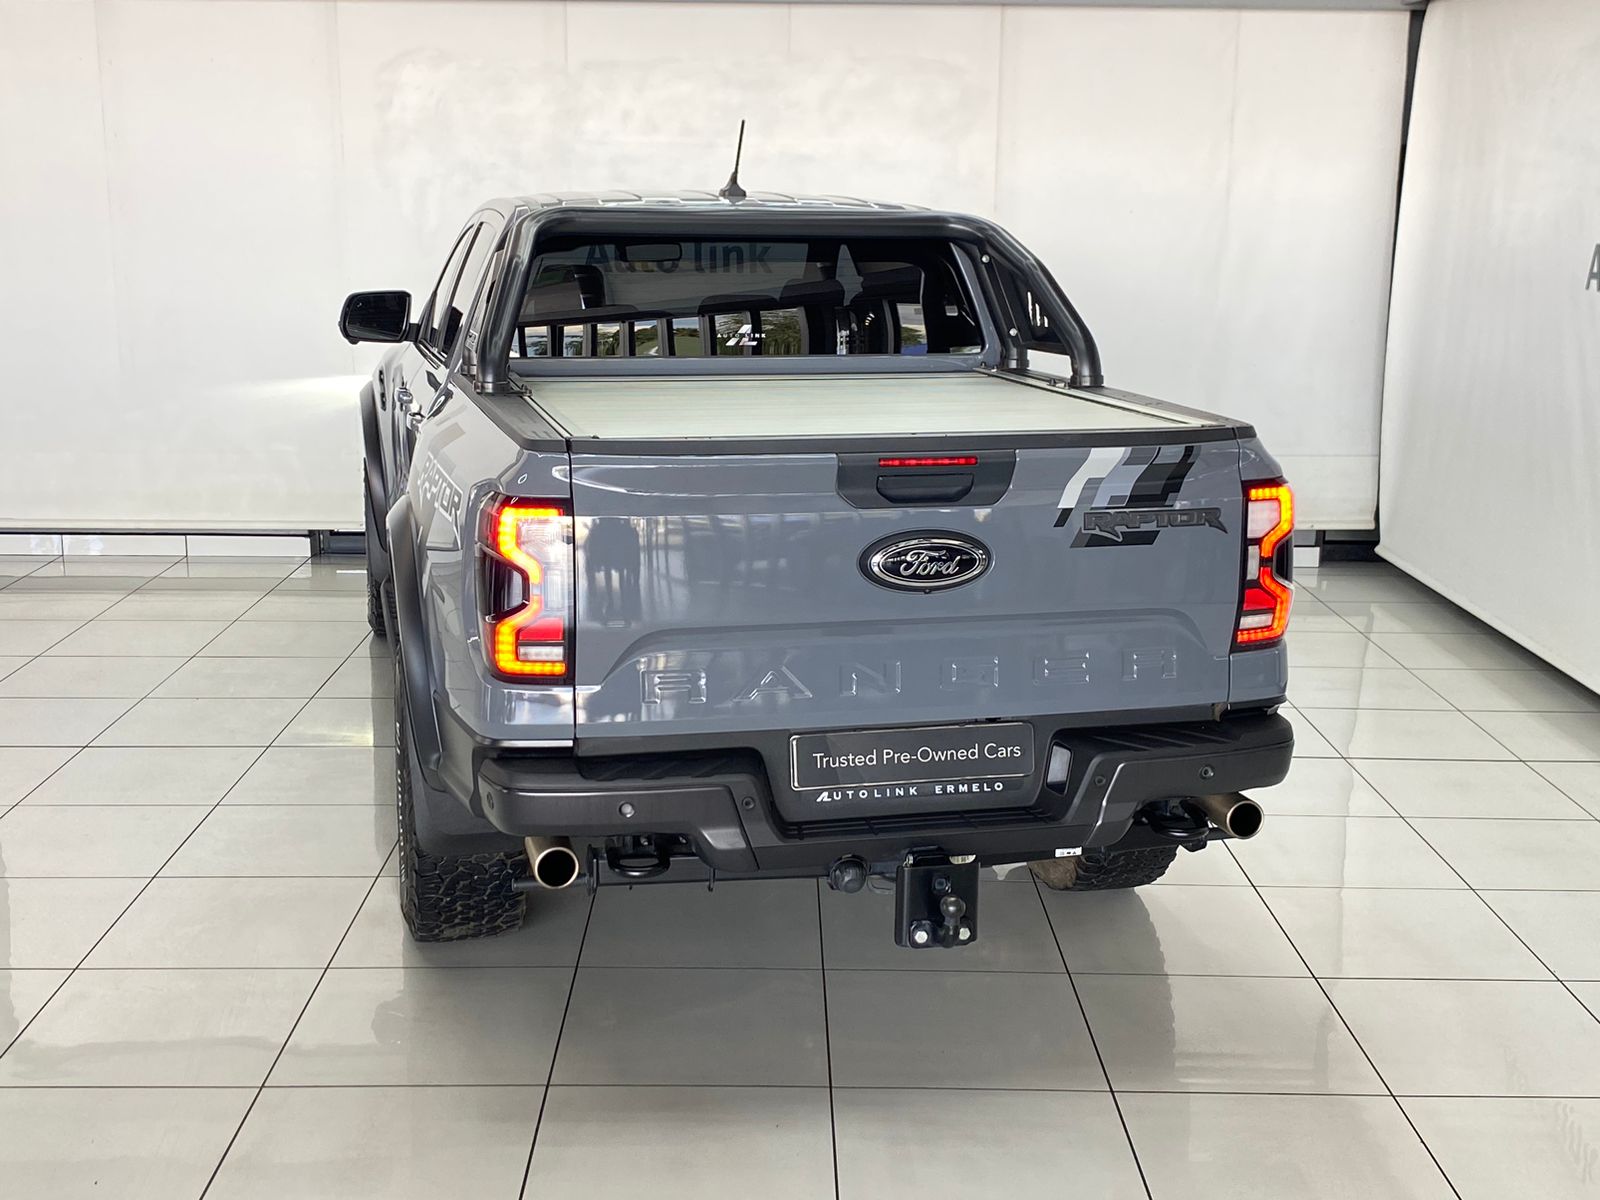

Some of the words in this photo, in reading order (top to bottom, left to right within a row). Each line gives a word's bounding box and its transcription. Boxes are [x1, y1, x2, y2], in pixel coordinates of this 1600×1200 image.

[1083, 507, 1228, 541] RAPTOR
[900, 549, 961, 576] Ford
[639, 647, 1179, 705] RANGER
[812, 748, 877, 769] Trusted
[883, 743, 979, 765] Pre-Owned
[984, 742, 1021, 759] Cars
[816, 786, 918, 802] AUTOLINK
[935, 781, 1004, 794] ERMELO
